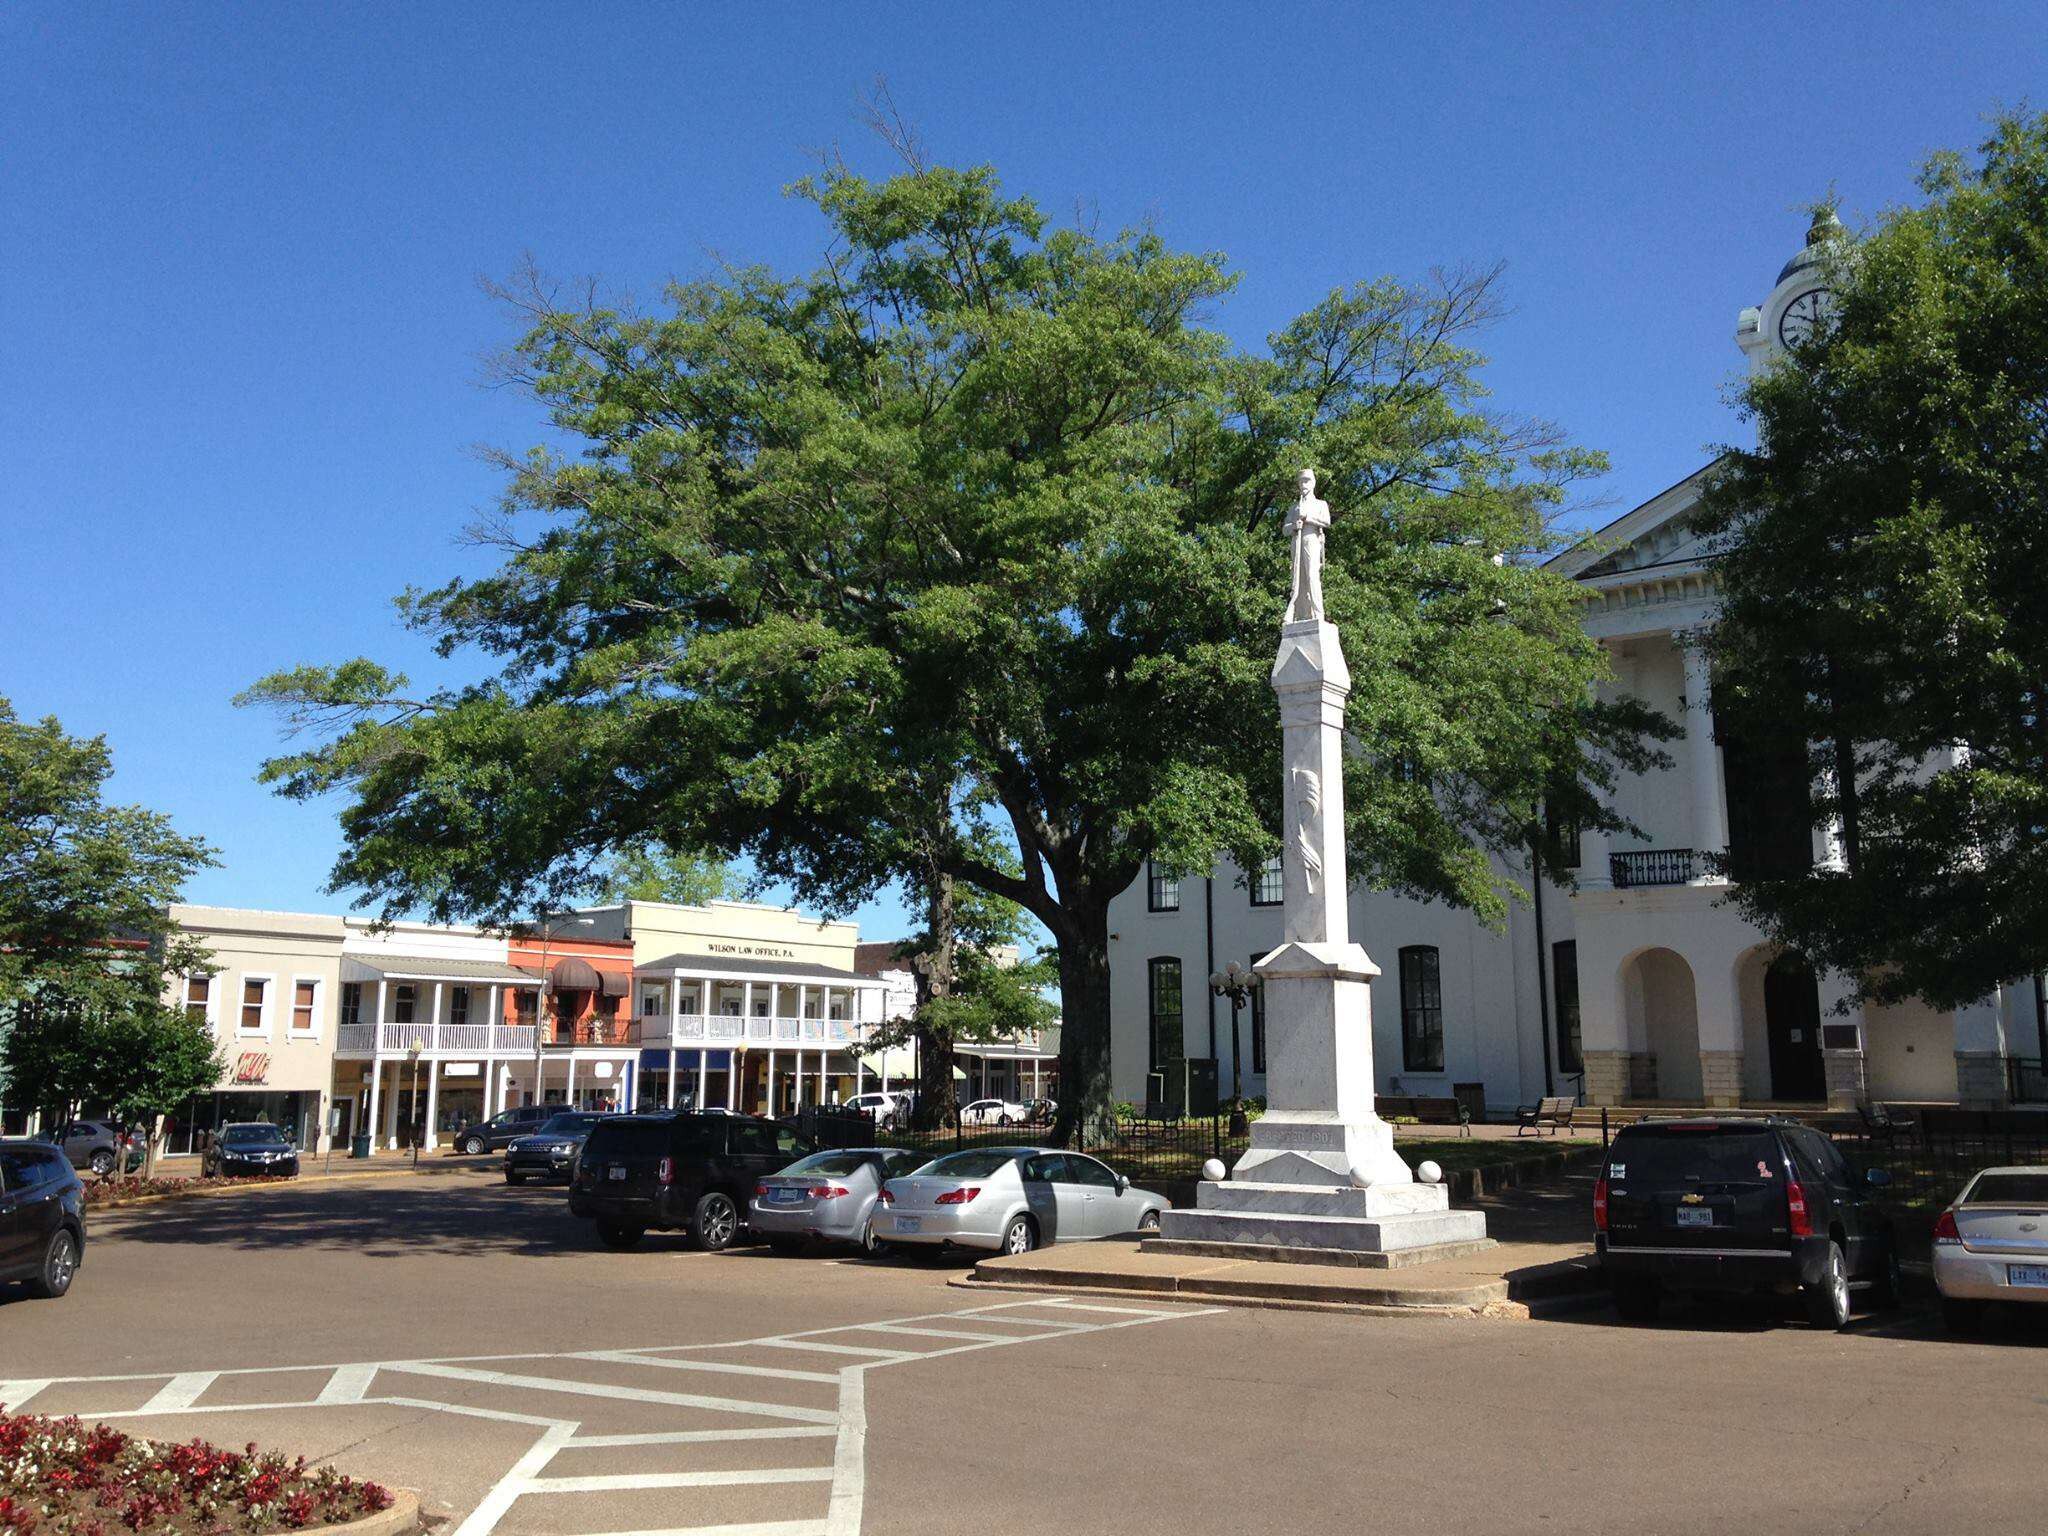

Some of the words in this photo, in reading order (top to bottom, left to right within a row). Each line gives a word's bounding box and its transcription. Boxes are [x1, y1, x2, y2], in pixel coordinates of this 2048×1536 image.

[708, 944, 736, 953] WILSON
[738, 946, 752, 954] LAW
[755, 947, 781, 957] OFFICE,
